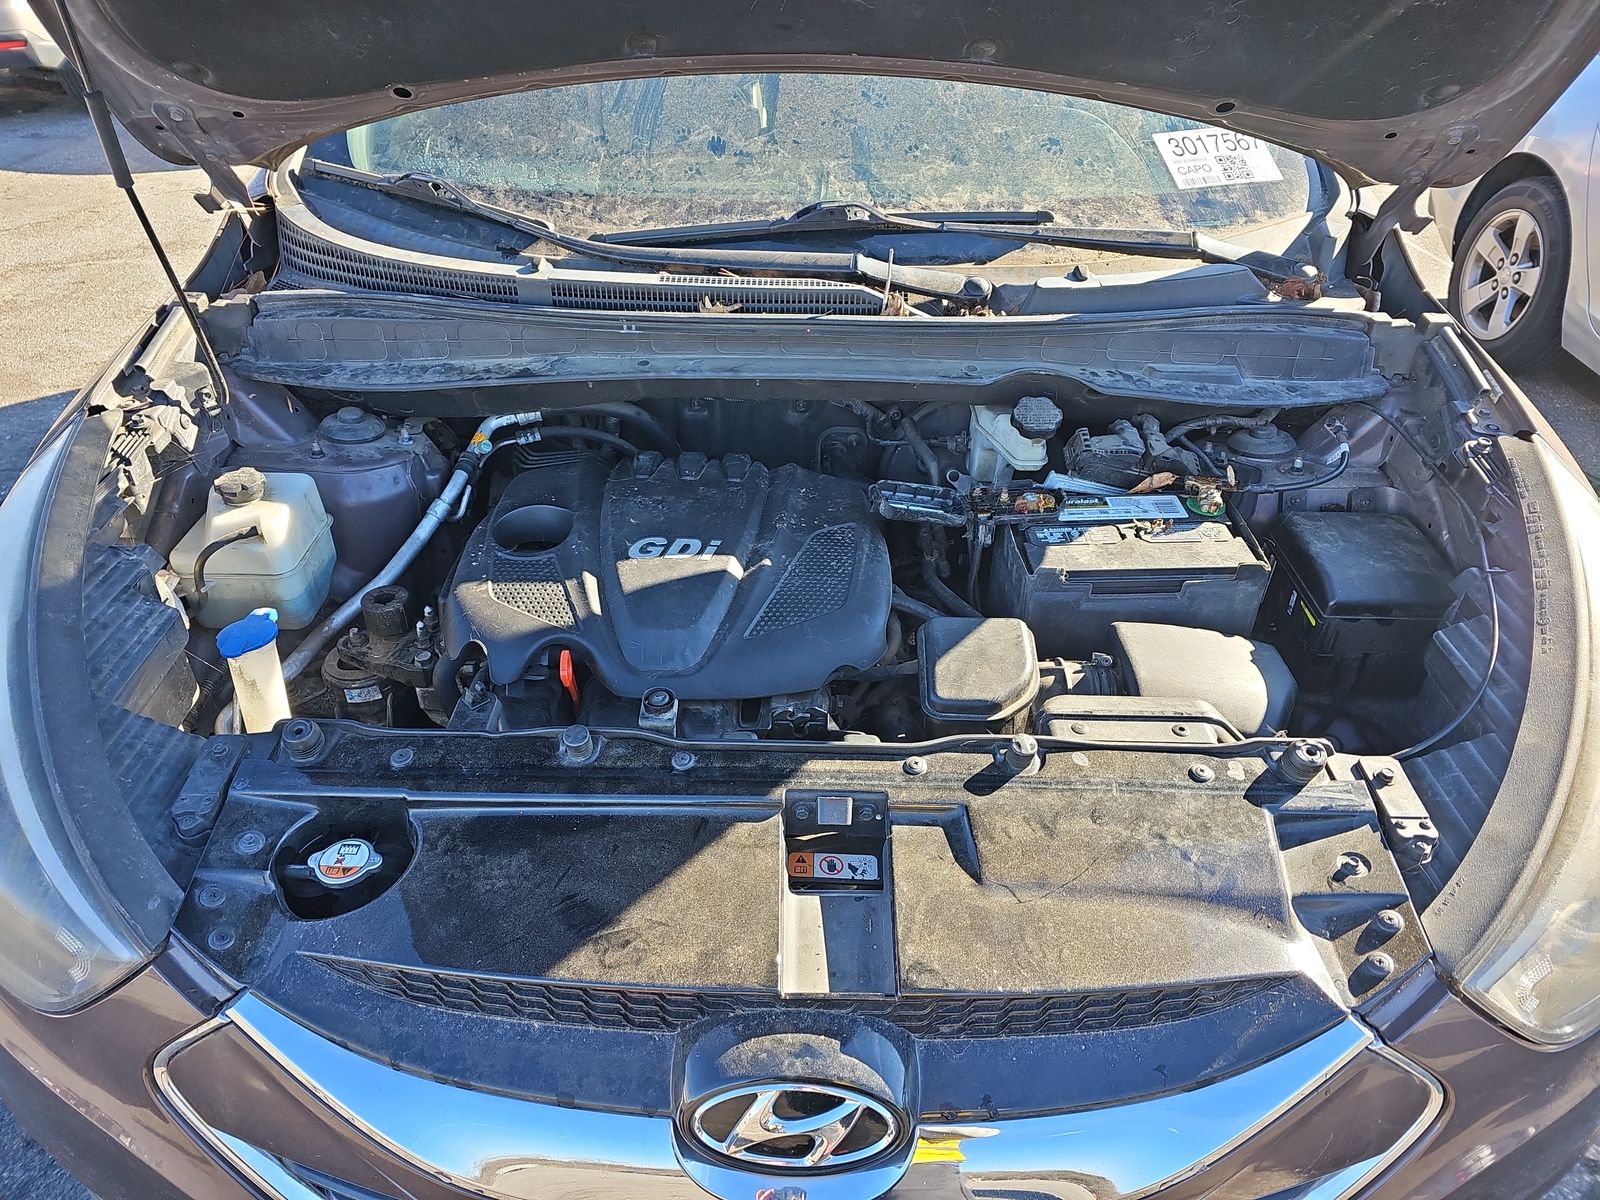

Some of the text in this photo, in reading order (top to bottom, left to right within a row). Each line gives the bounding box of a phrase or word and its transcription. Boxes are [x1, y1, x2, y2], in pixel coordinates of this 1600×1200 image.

[1177, 163, 1212, 175] CAPO
[1065, 497, 1100, 505] uralast
[628, 537, 724, 561] GDi
